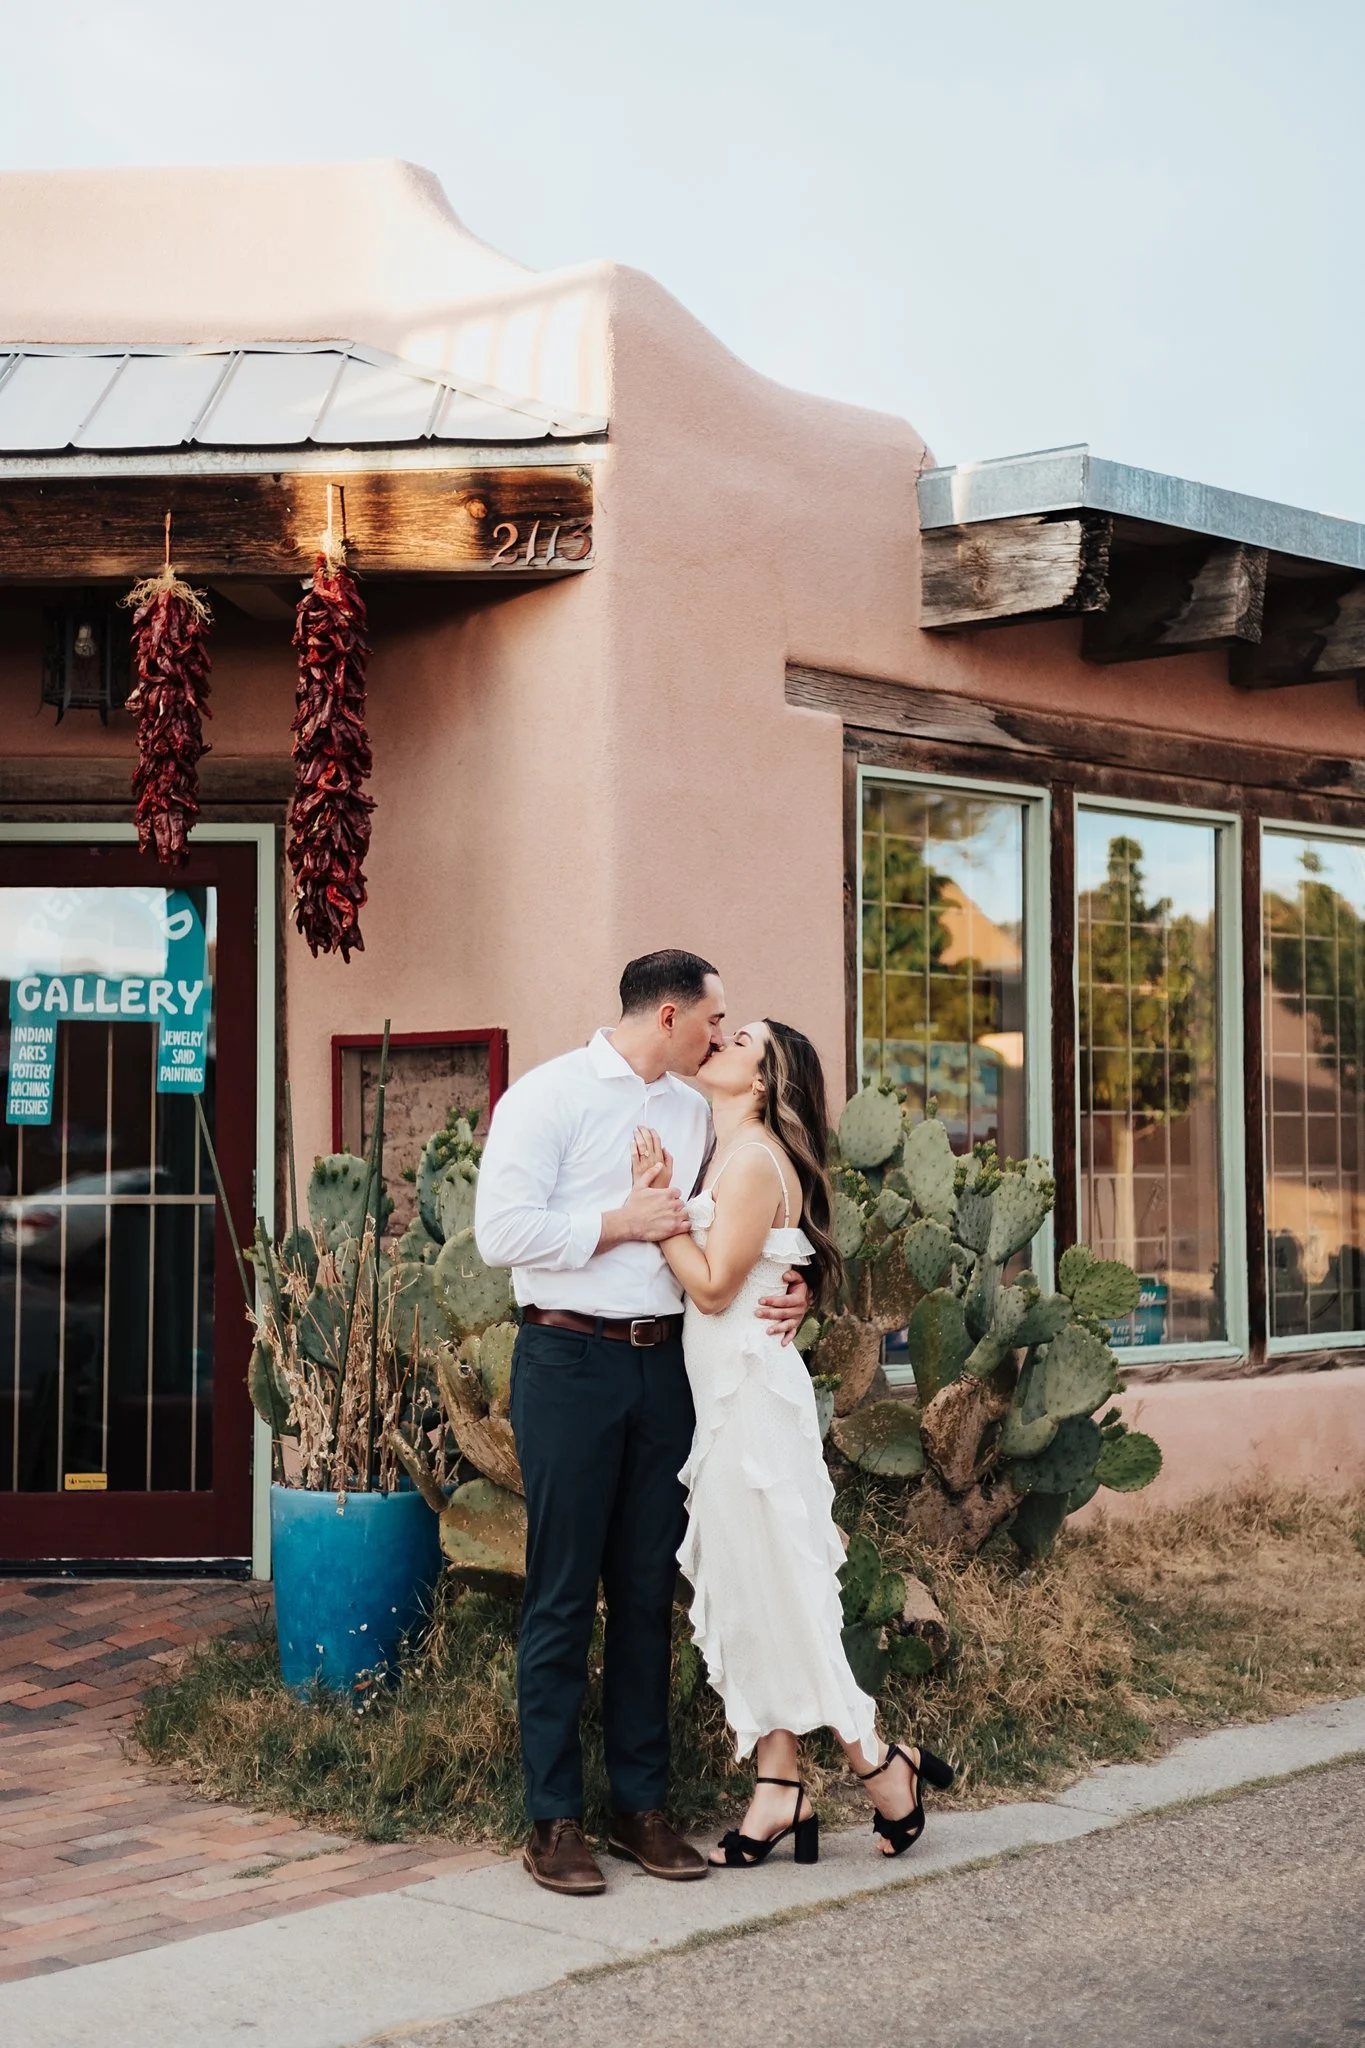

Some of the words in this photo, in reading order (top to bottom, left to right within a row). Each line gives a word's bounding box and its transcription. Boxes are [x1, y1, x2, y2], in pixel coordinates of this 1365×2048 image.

[490, 516, 593, 568] 2113
[16, 977, 204, 1016] GALLERY
[14, 1026, 53, 1043] INDIAN
[162, 1030, 204, 1047] JEWELRY
[18, 1045, 47, 1062] ARTS
[171, 1049, 196, 1065] SAND
[12, 1063, 52, 1080] POTTERY
[160, 1065, 203, 1083] PAINTINGS
[10, 1081, 50, 1098] KACHINAS
[10, 1098, 48, 1116] FETISHES
